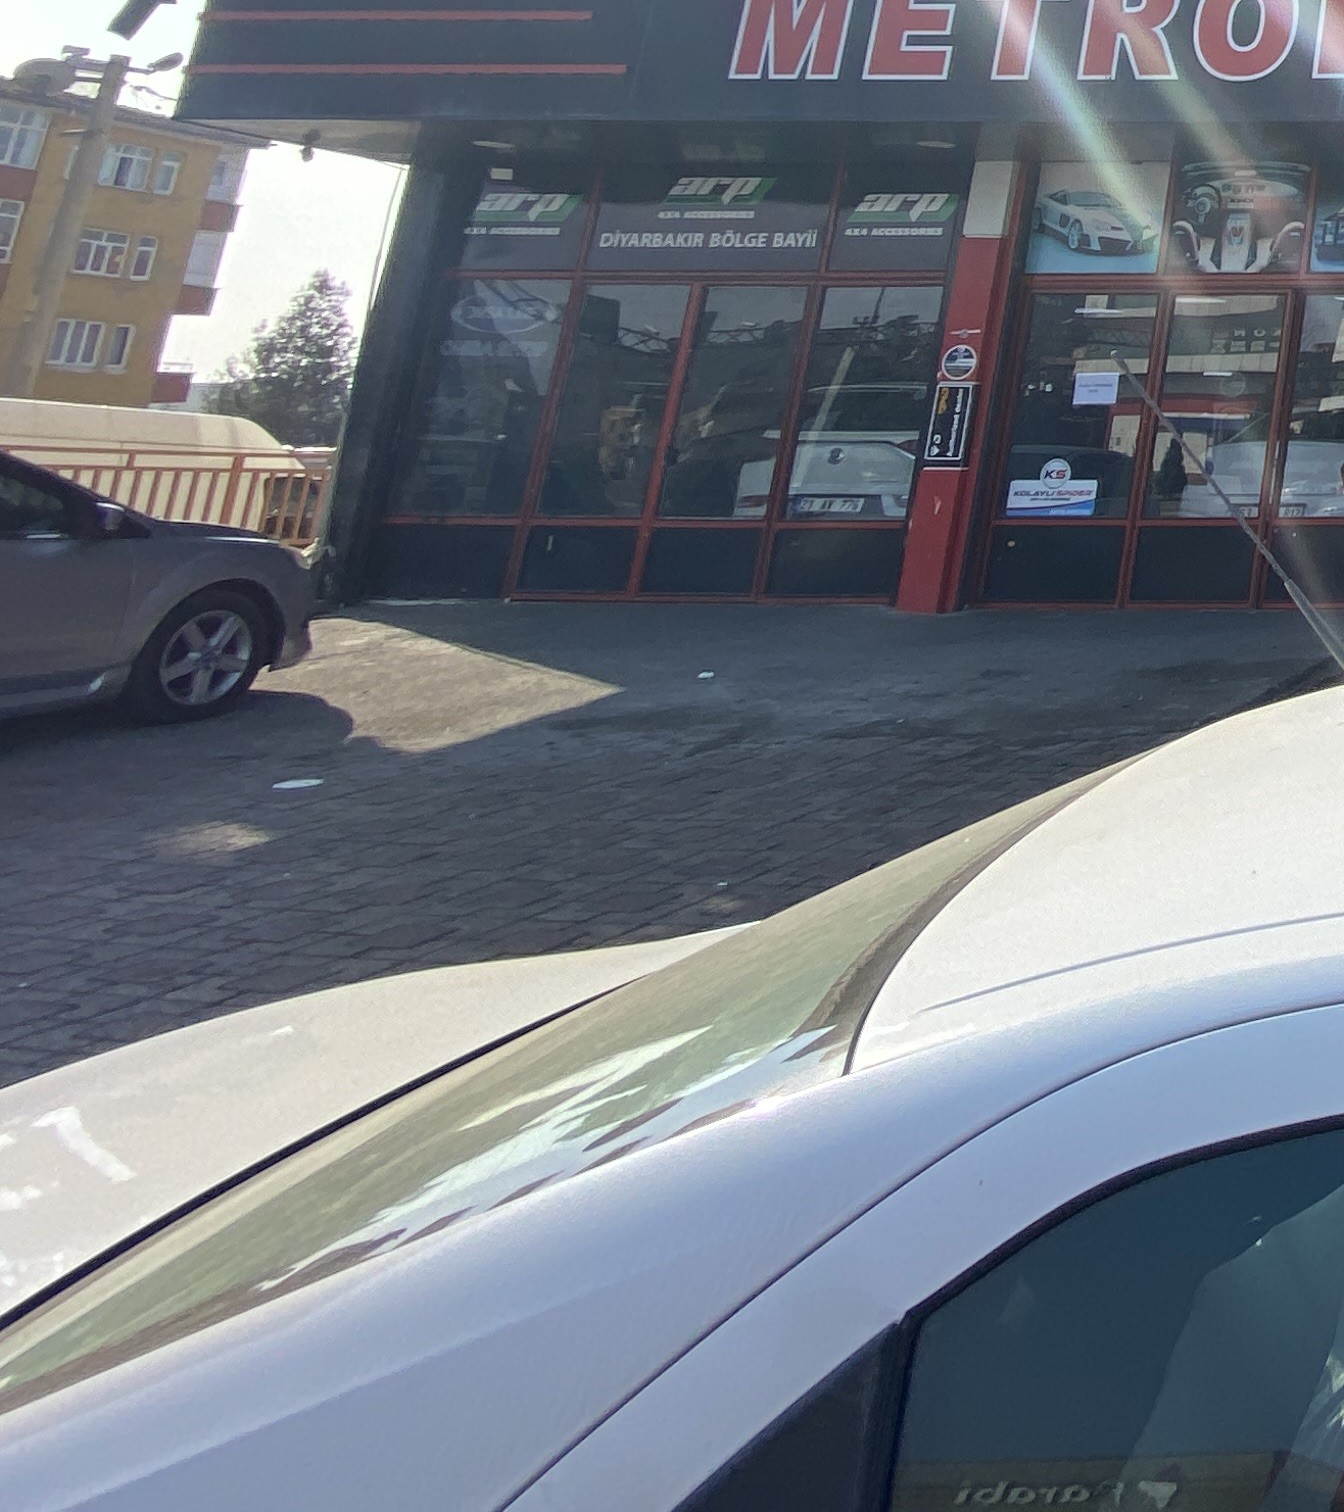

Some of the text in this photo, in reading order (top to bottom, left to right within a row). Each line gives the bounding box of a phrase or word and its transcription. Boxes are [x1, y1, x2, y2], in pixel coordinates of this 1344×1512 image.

[669, 177, 762, 205] arp
[476, 193, 570, 222] arp
[855, 193, 950, 222] arp
[600, 230, 704, 248] DİYARBAKIR
[709, 229, 768, 248] BÖLGE
[1044, 469, 1067, 479] KS
